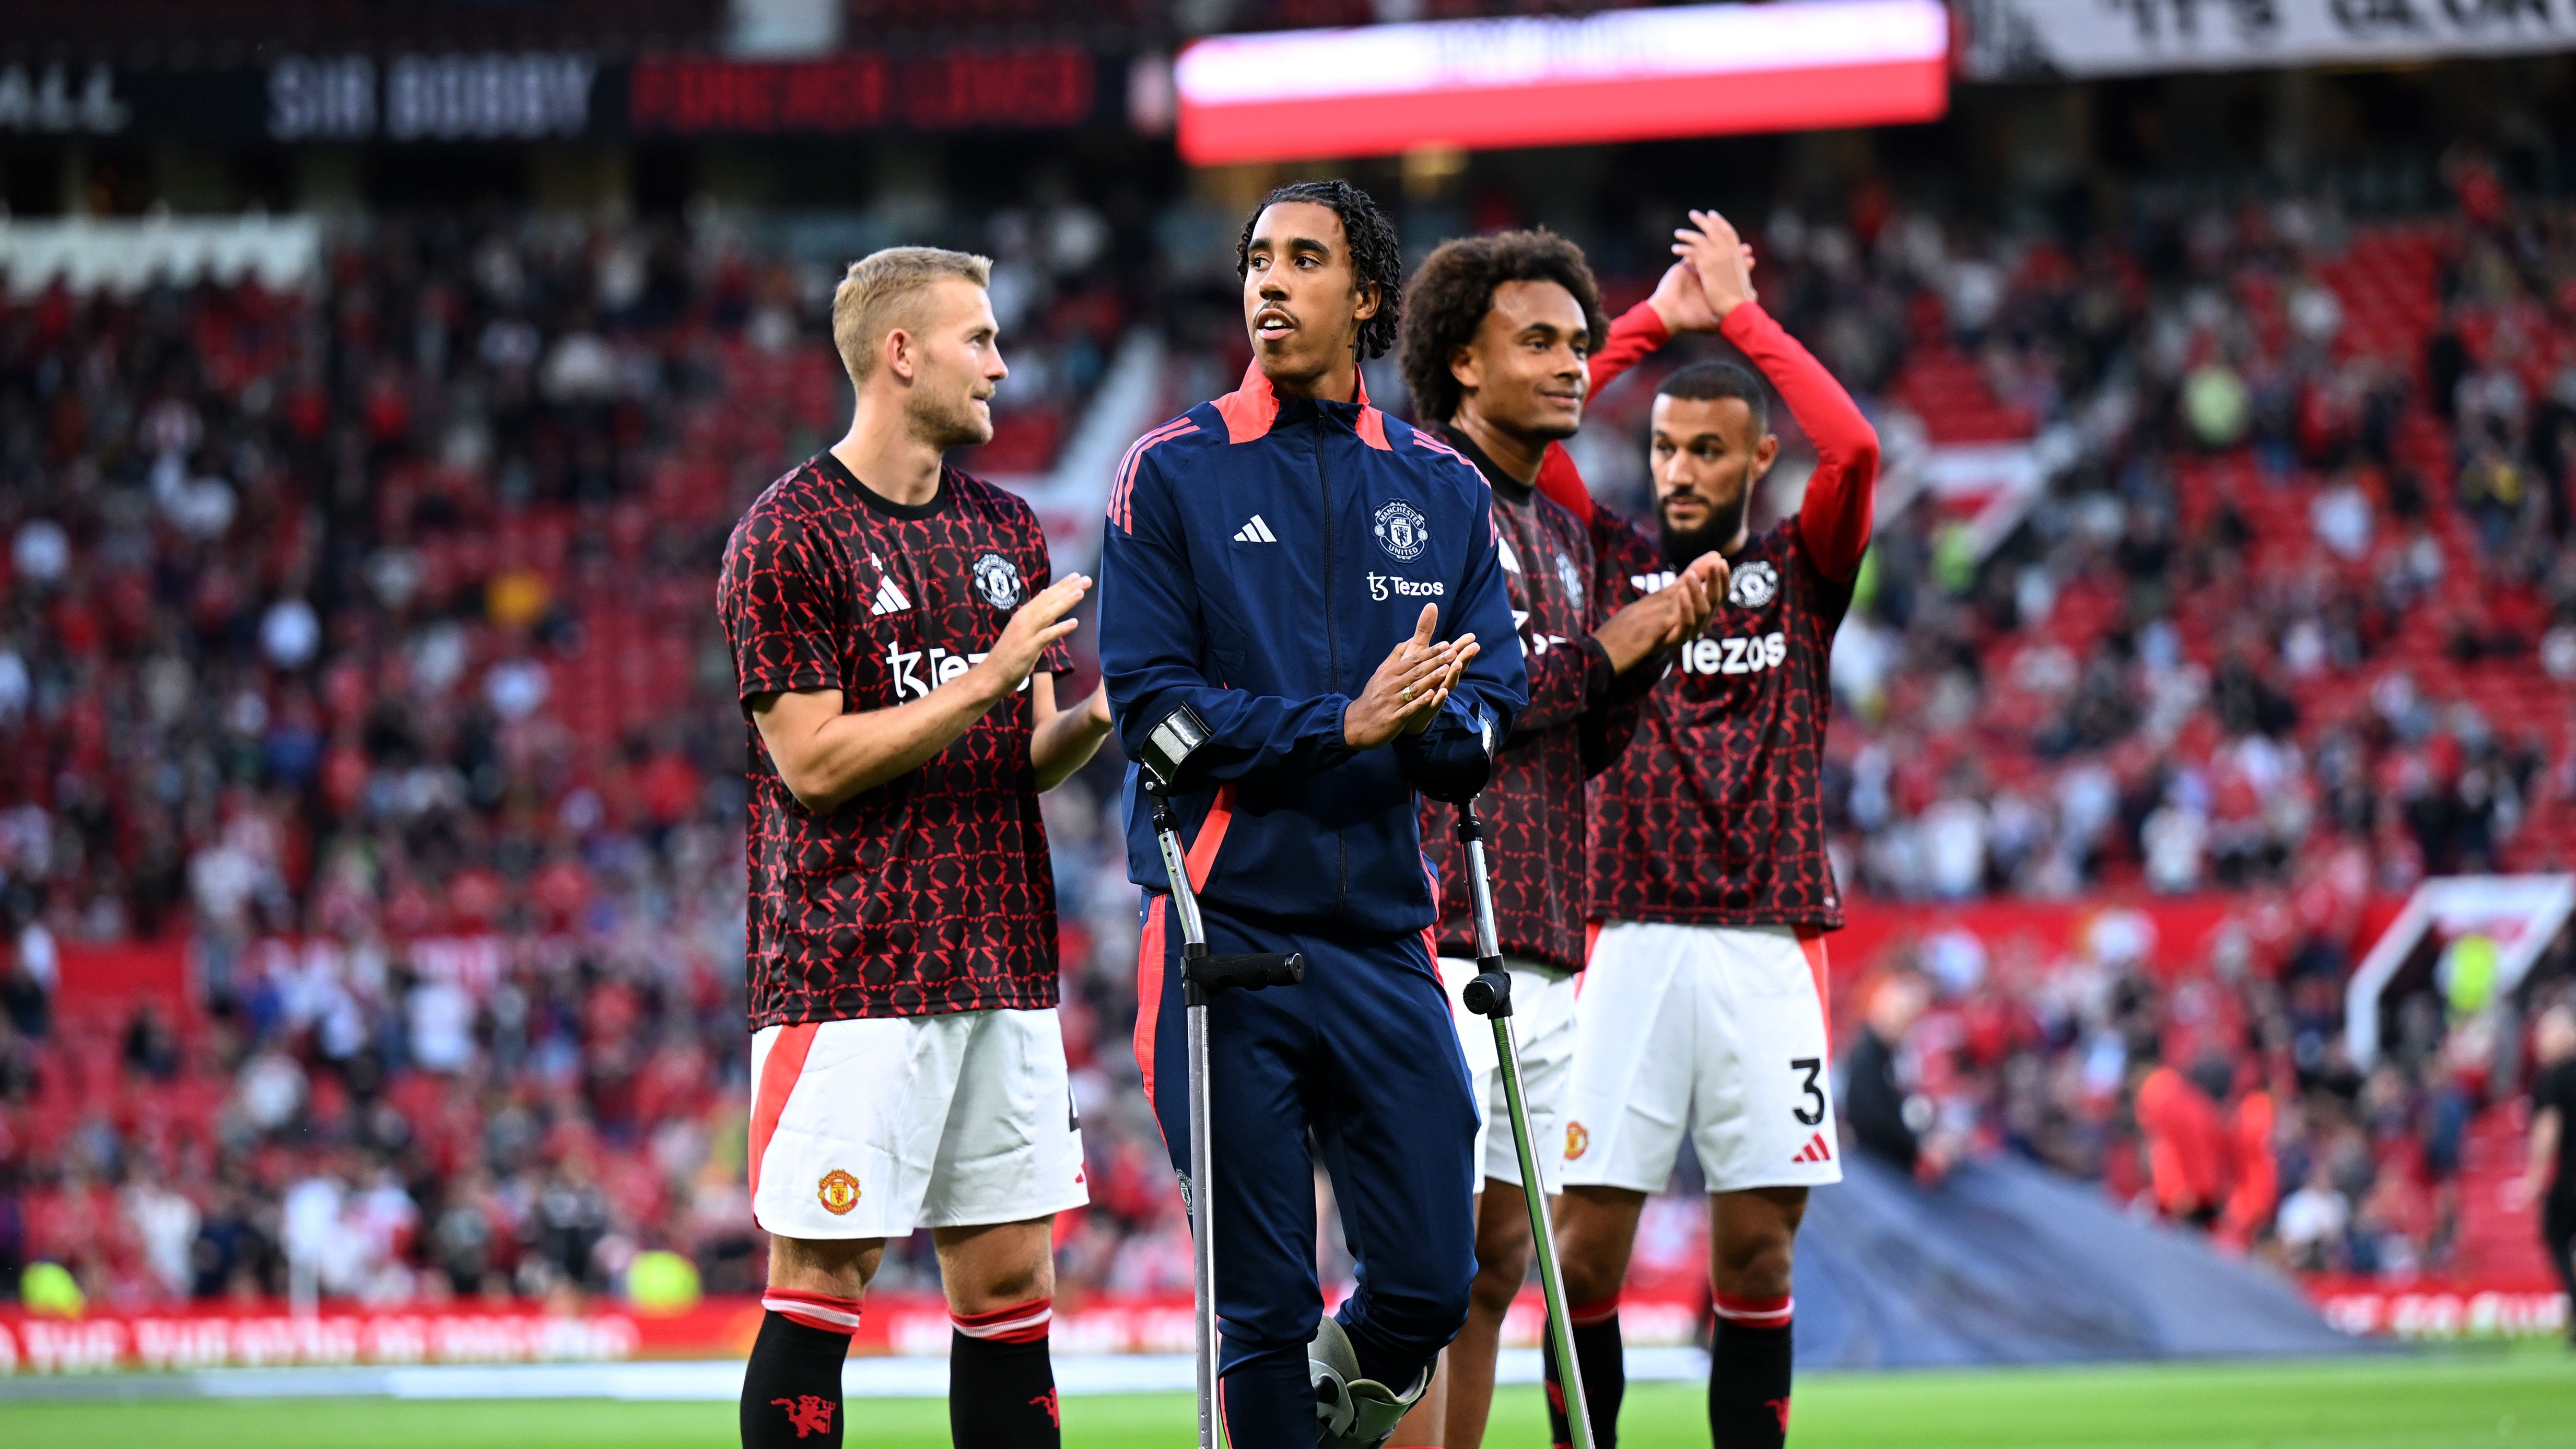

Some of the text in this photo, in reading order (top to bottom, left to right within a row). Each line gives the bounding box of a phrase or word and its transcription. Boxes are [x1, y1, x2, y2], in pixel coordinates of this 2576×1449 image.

[265, 56, 375, 138] SIR
[385, 54, 596, 138] BOBBY
[1378, 506, 1422, 527] MANCHESTER
[1388, 544, 1419, 556] UNITED
[1390, 576, 1444, 596] Tezos
[1790, 1058, 1825, 1126] 3
